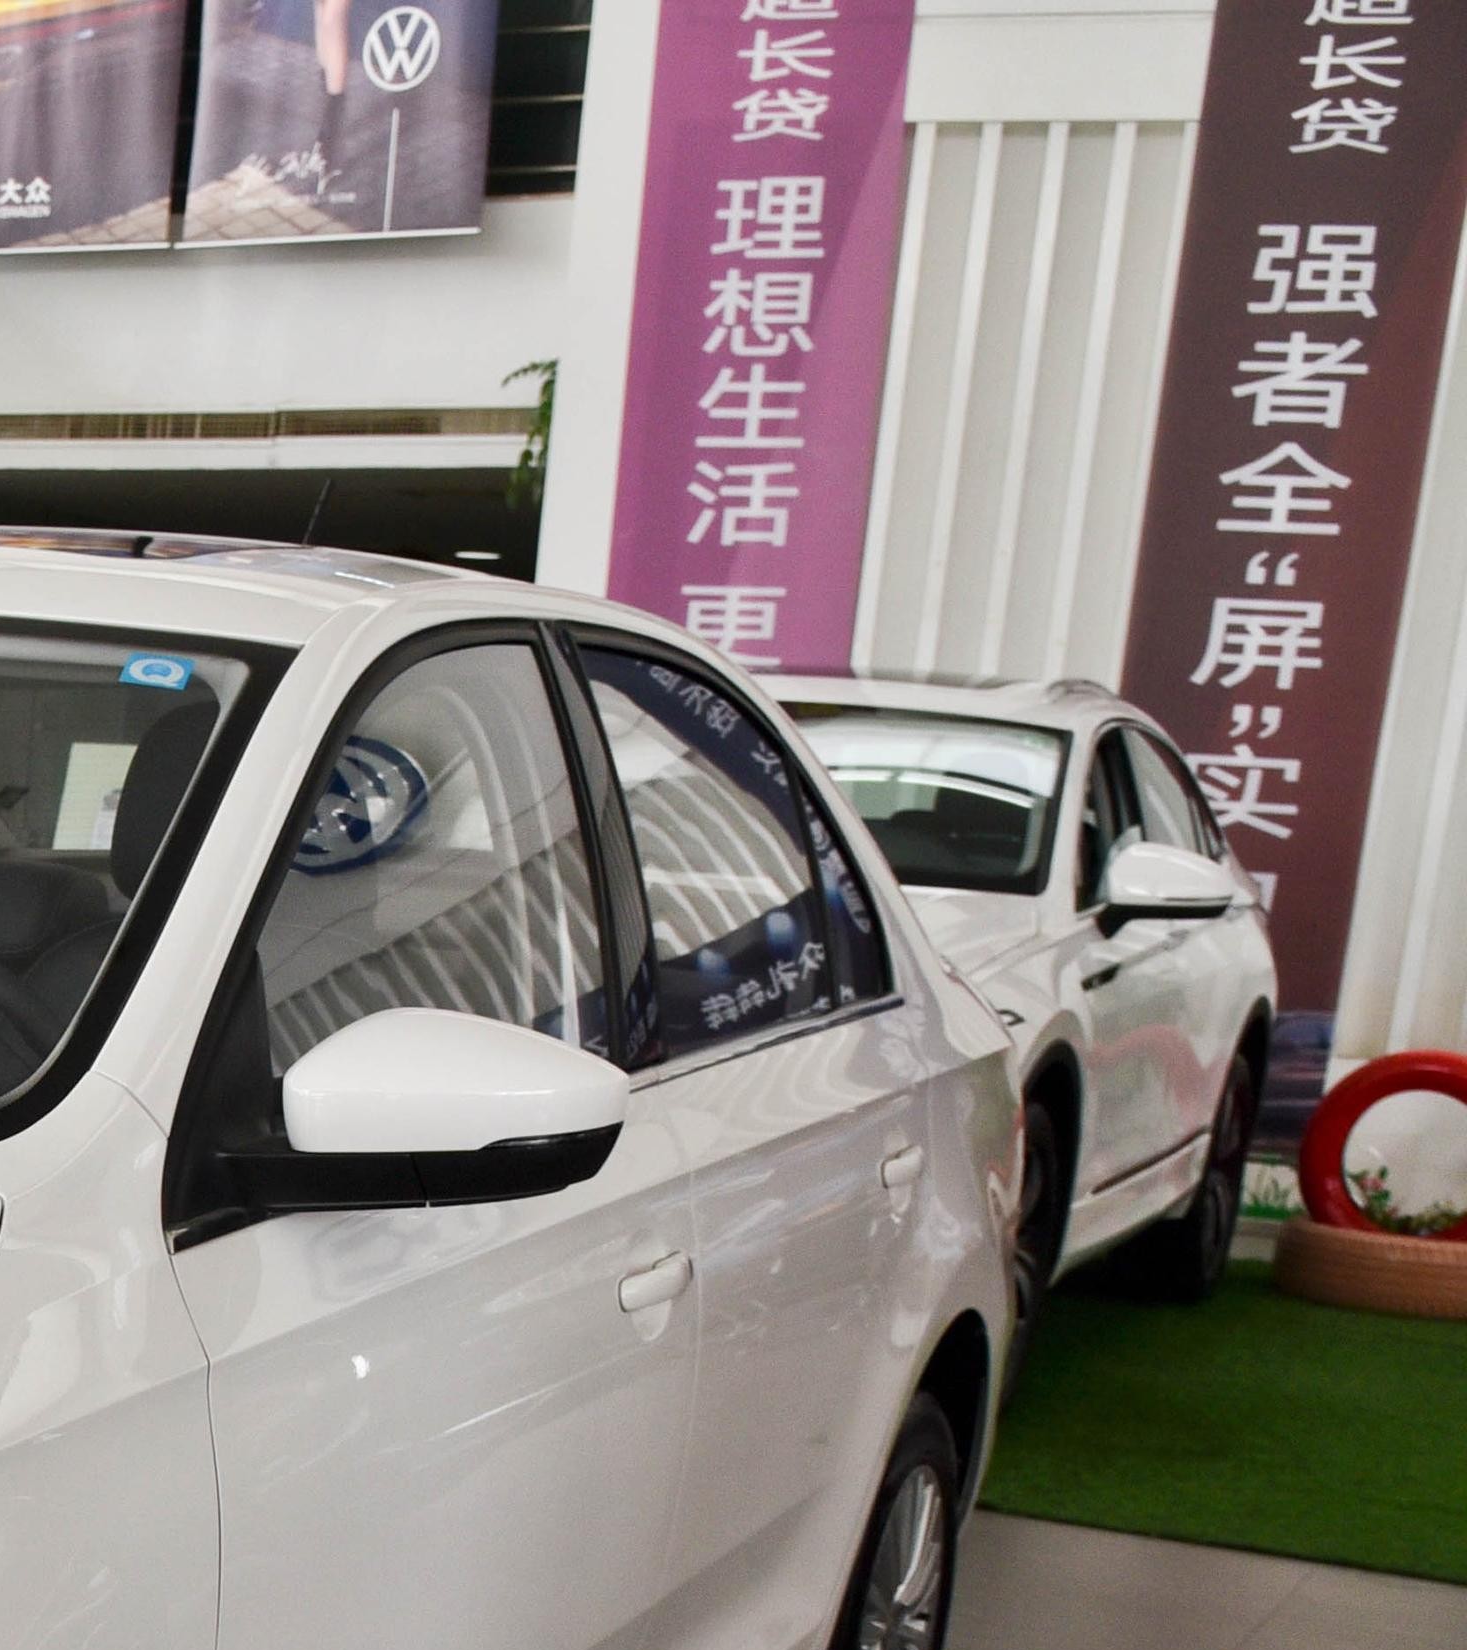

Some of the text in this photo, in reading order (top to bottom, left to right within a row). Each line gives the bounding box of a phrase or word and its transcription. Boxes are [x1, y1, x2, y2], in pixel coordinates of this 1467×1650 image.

[687, 176, 825, 547] 理想生活
[1186, 224, 1378, 912] 强者全“屏”实
